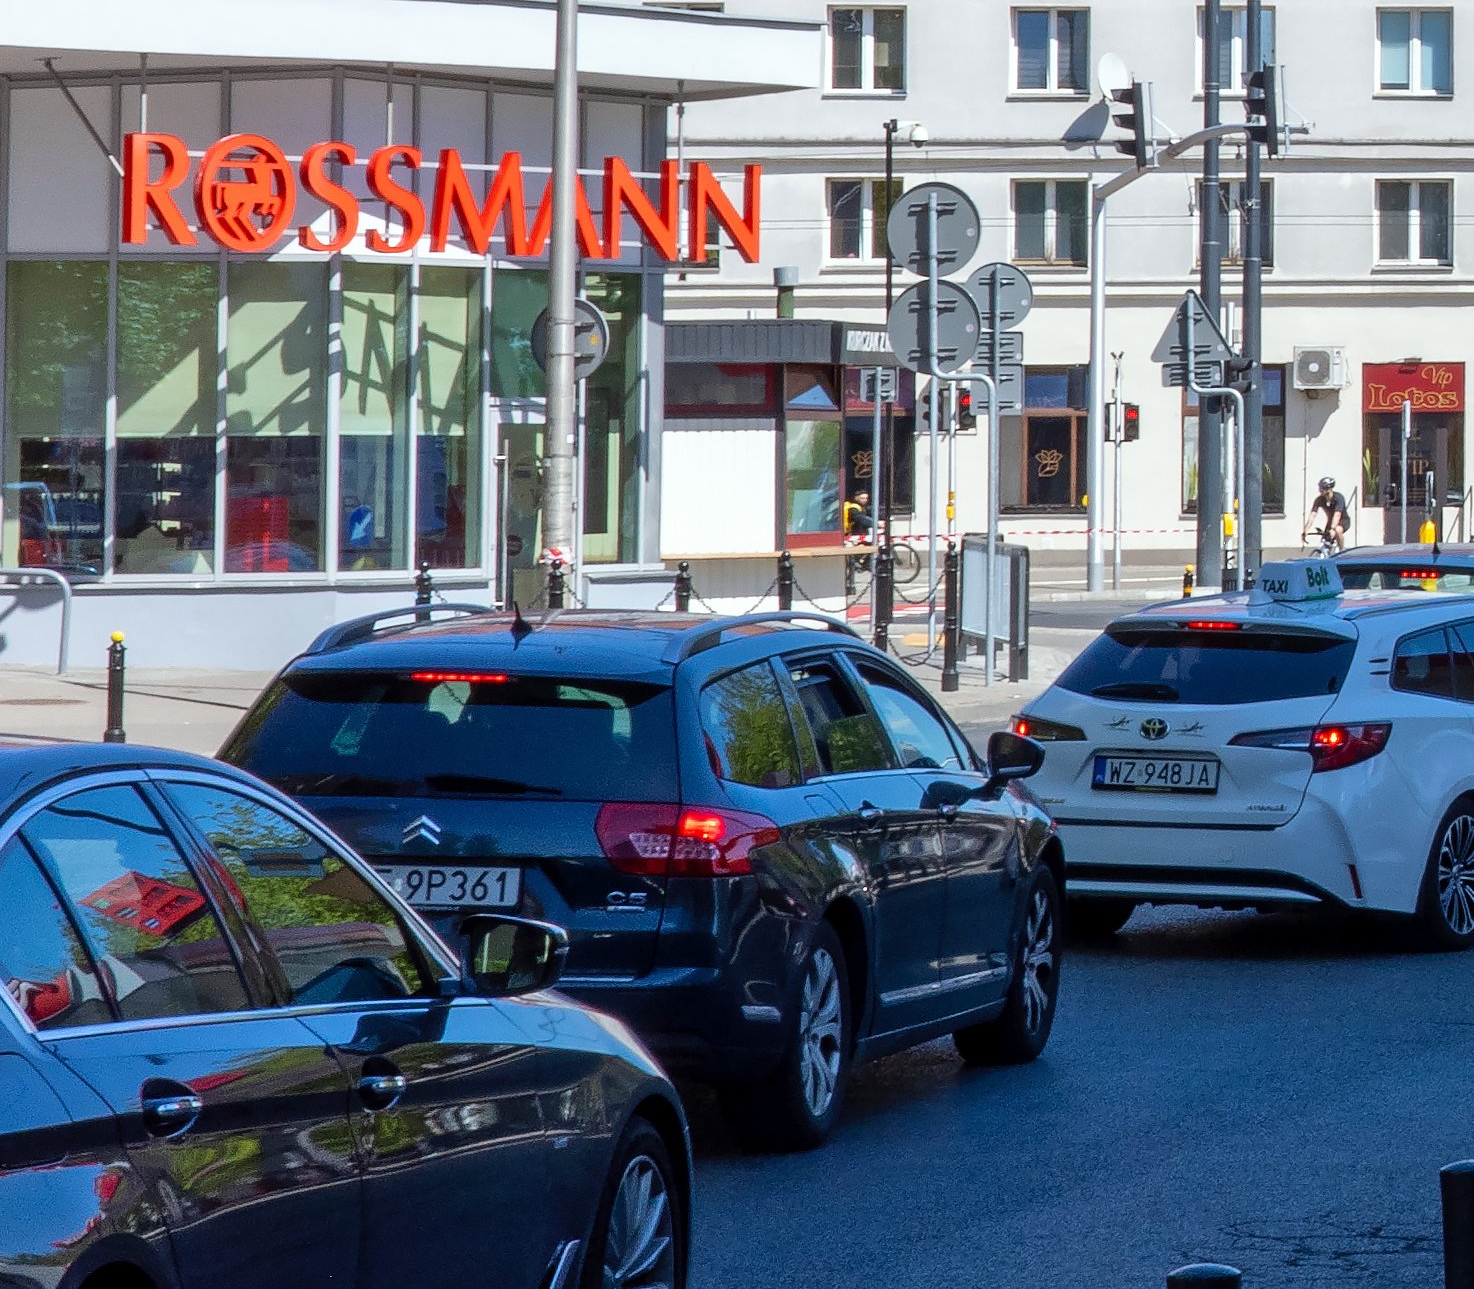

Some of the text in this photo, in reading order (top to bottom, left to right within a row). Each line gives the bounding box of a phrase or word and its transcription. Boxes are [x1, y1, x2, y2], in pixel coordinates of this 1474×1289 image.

[121, 132, 762, 264] ROSSMANN
[1262, 579, 1289, 593] TAXI
[1305, 566, 1330, 592] Bolt
[1110, 762, 1210, 786] WZ 948JA
[405, 869, 507, 903] 9P361
[606, 890, 648, 905] C5
